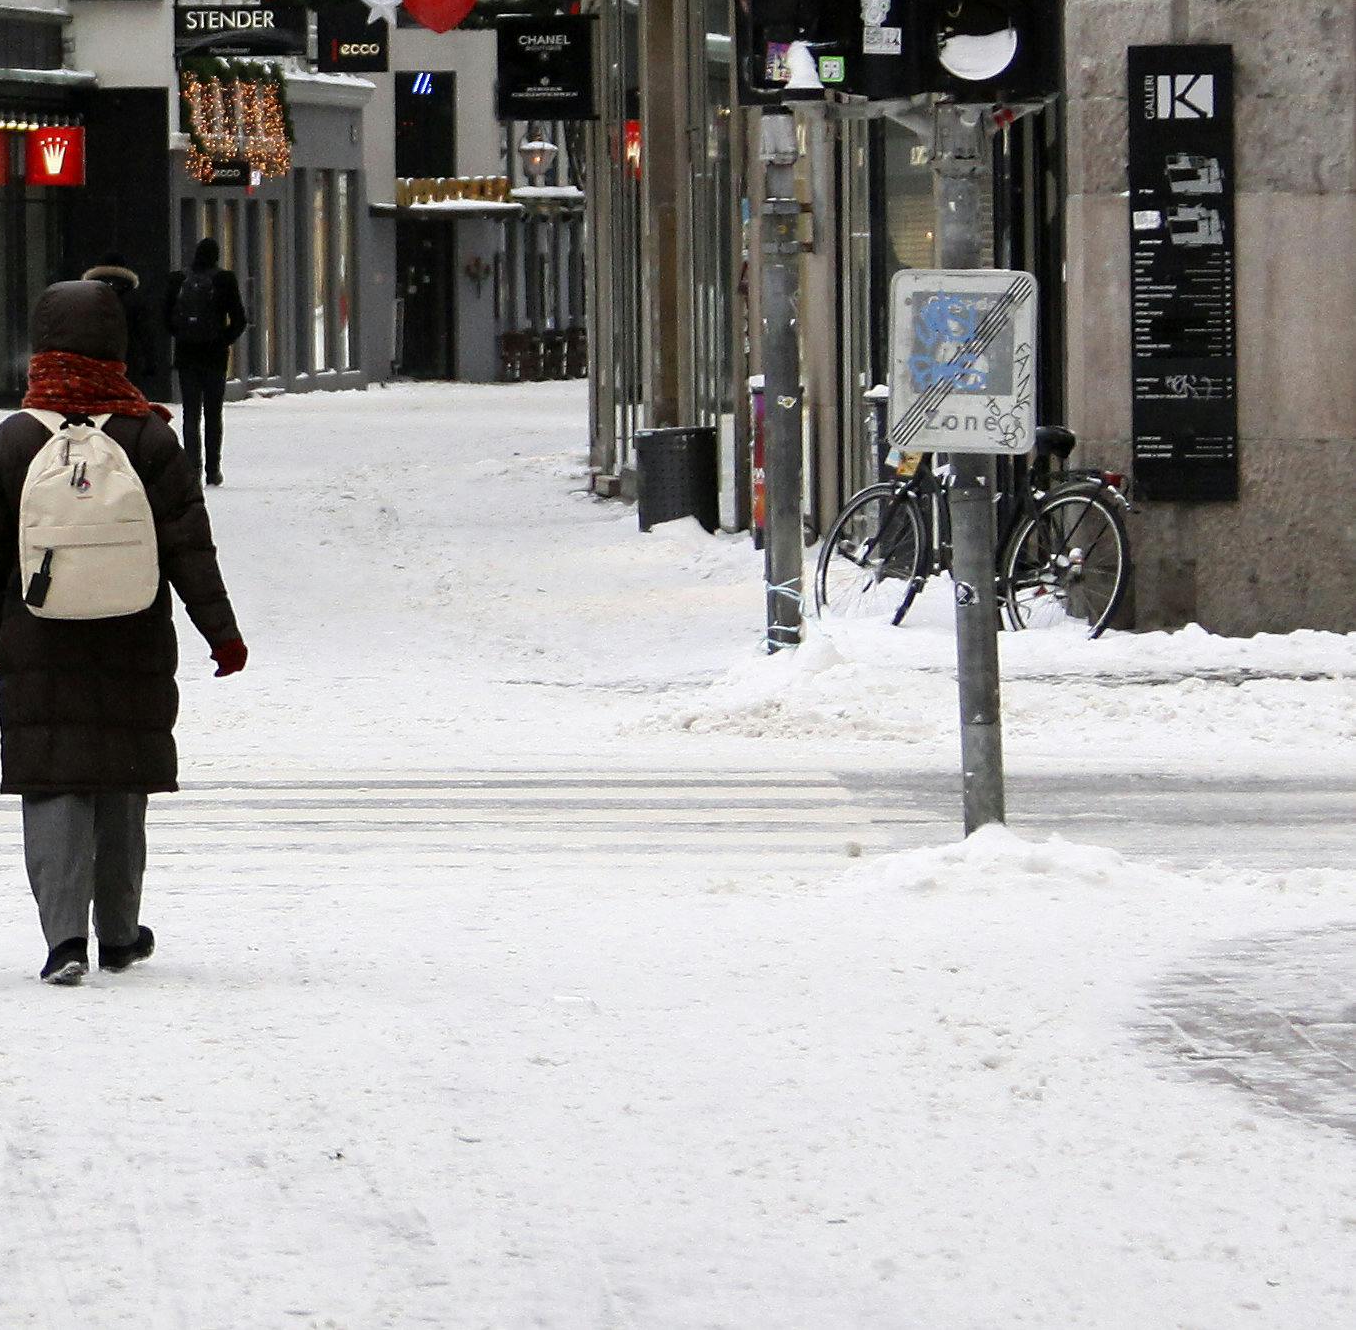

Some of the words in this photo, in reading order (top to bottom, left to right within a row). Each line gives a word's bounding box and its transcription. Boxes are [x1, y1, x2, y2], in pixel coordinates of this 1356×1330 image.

[186, 10, 275, 29] STENDER
[518, 34, 571, 45] CHANEL
[340, 43, 380, 55] ecco
[1144, 74, 1156, 120] GALLERI
